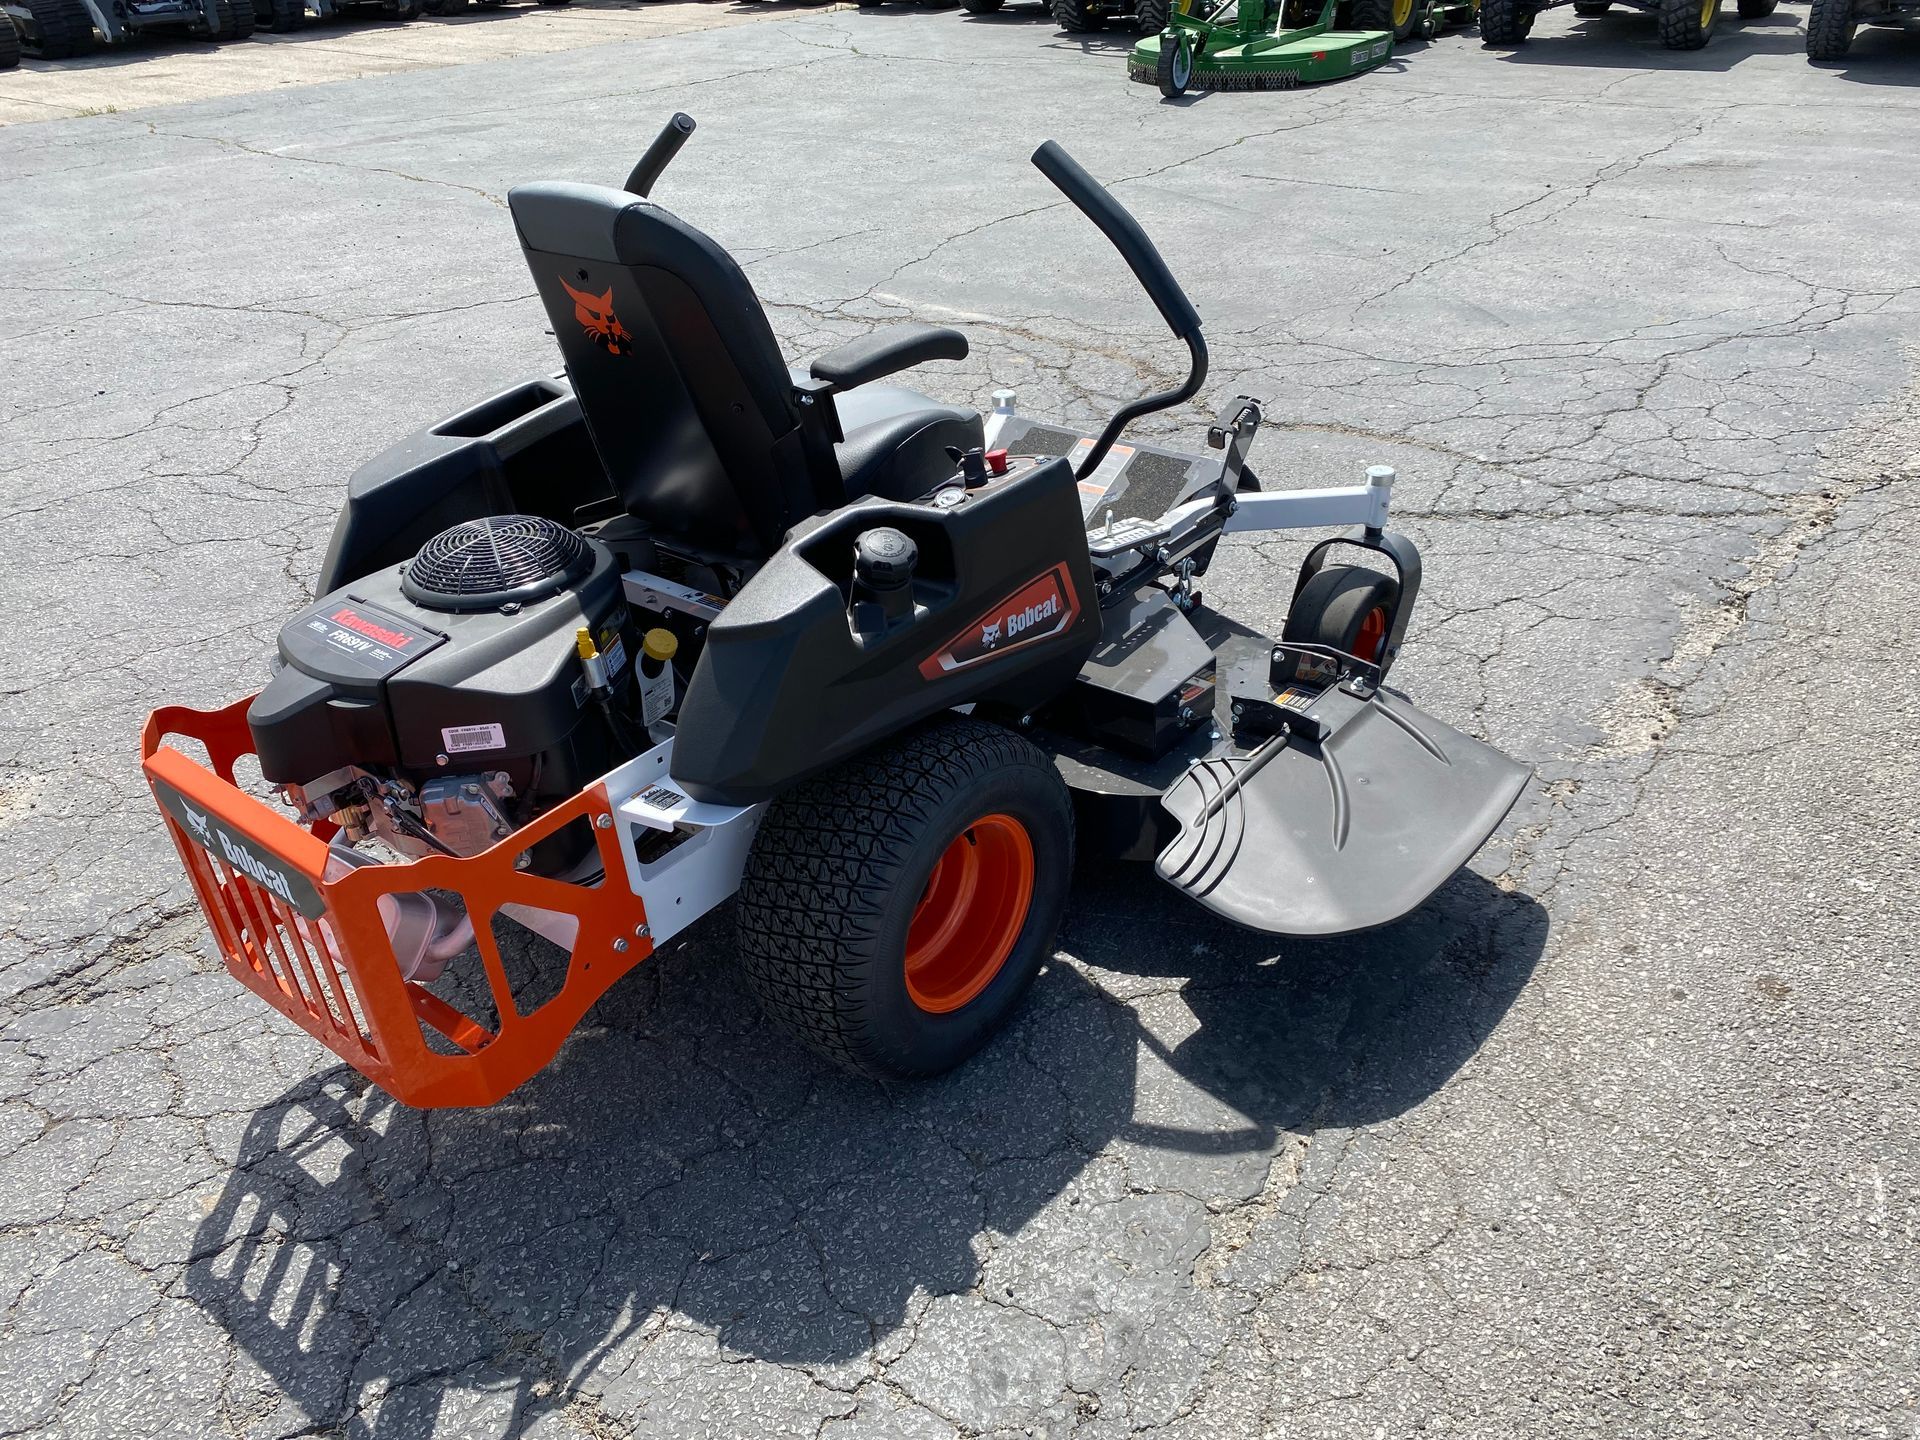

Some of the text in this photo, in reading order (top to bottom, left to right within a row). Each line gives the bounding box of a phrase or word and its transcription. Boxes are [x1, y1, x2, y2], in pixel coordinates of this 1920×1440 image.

[330, 608, 414, 649] Kawasaki
[1007, 593, 1058, 638] Bobcat
[327, 629, 374, 651] FR691V
[216, 828, 296, 905] Bobcat
